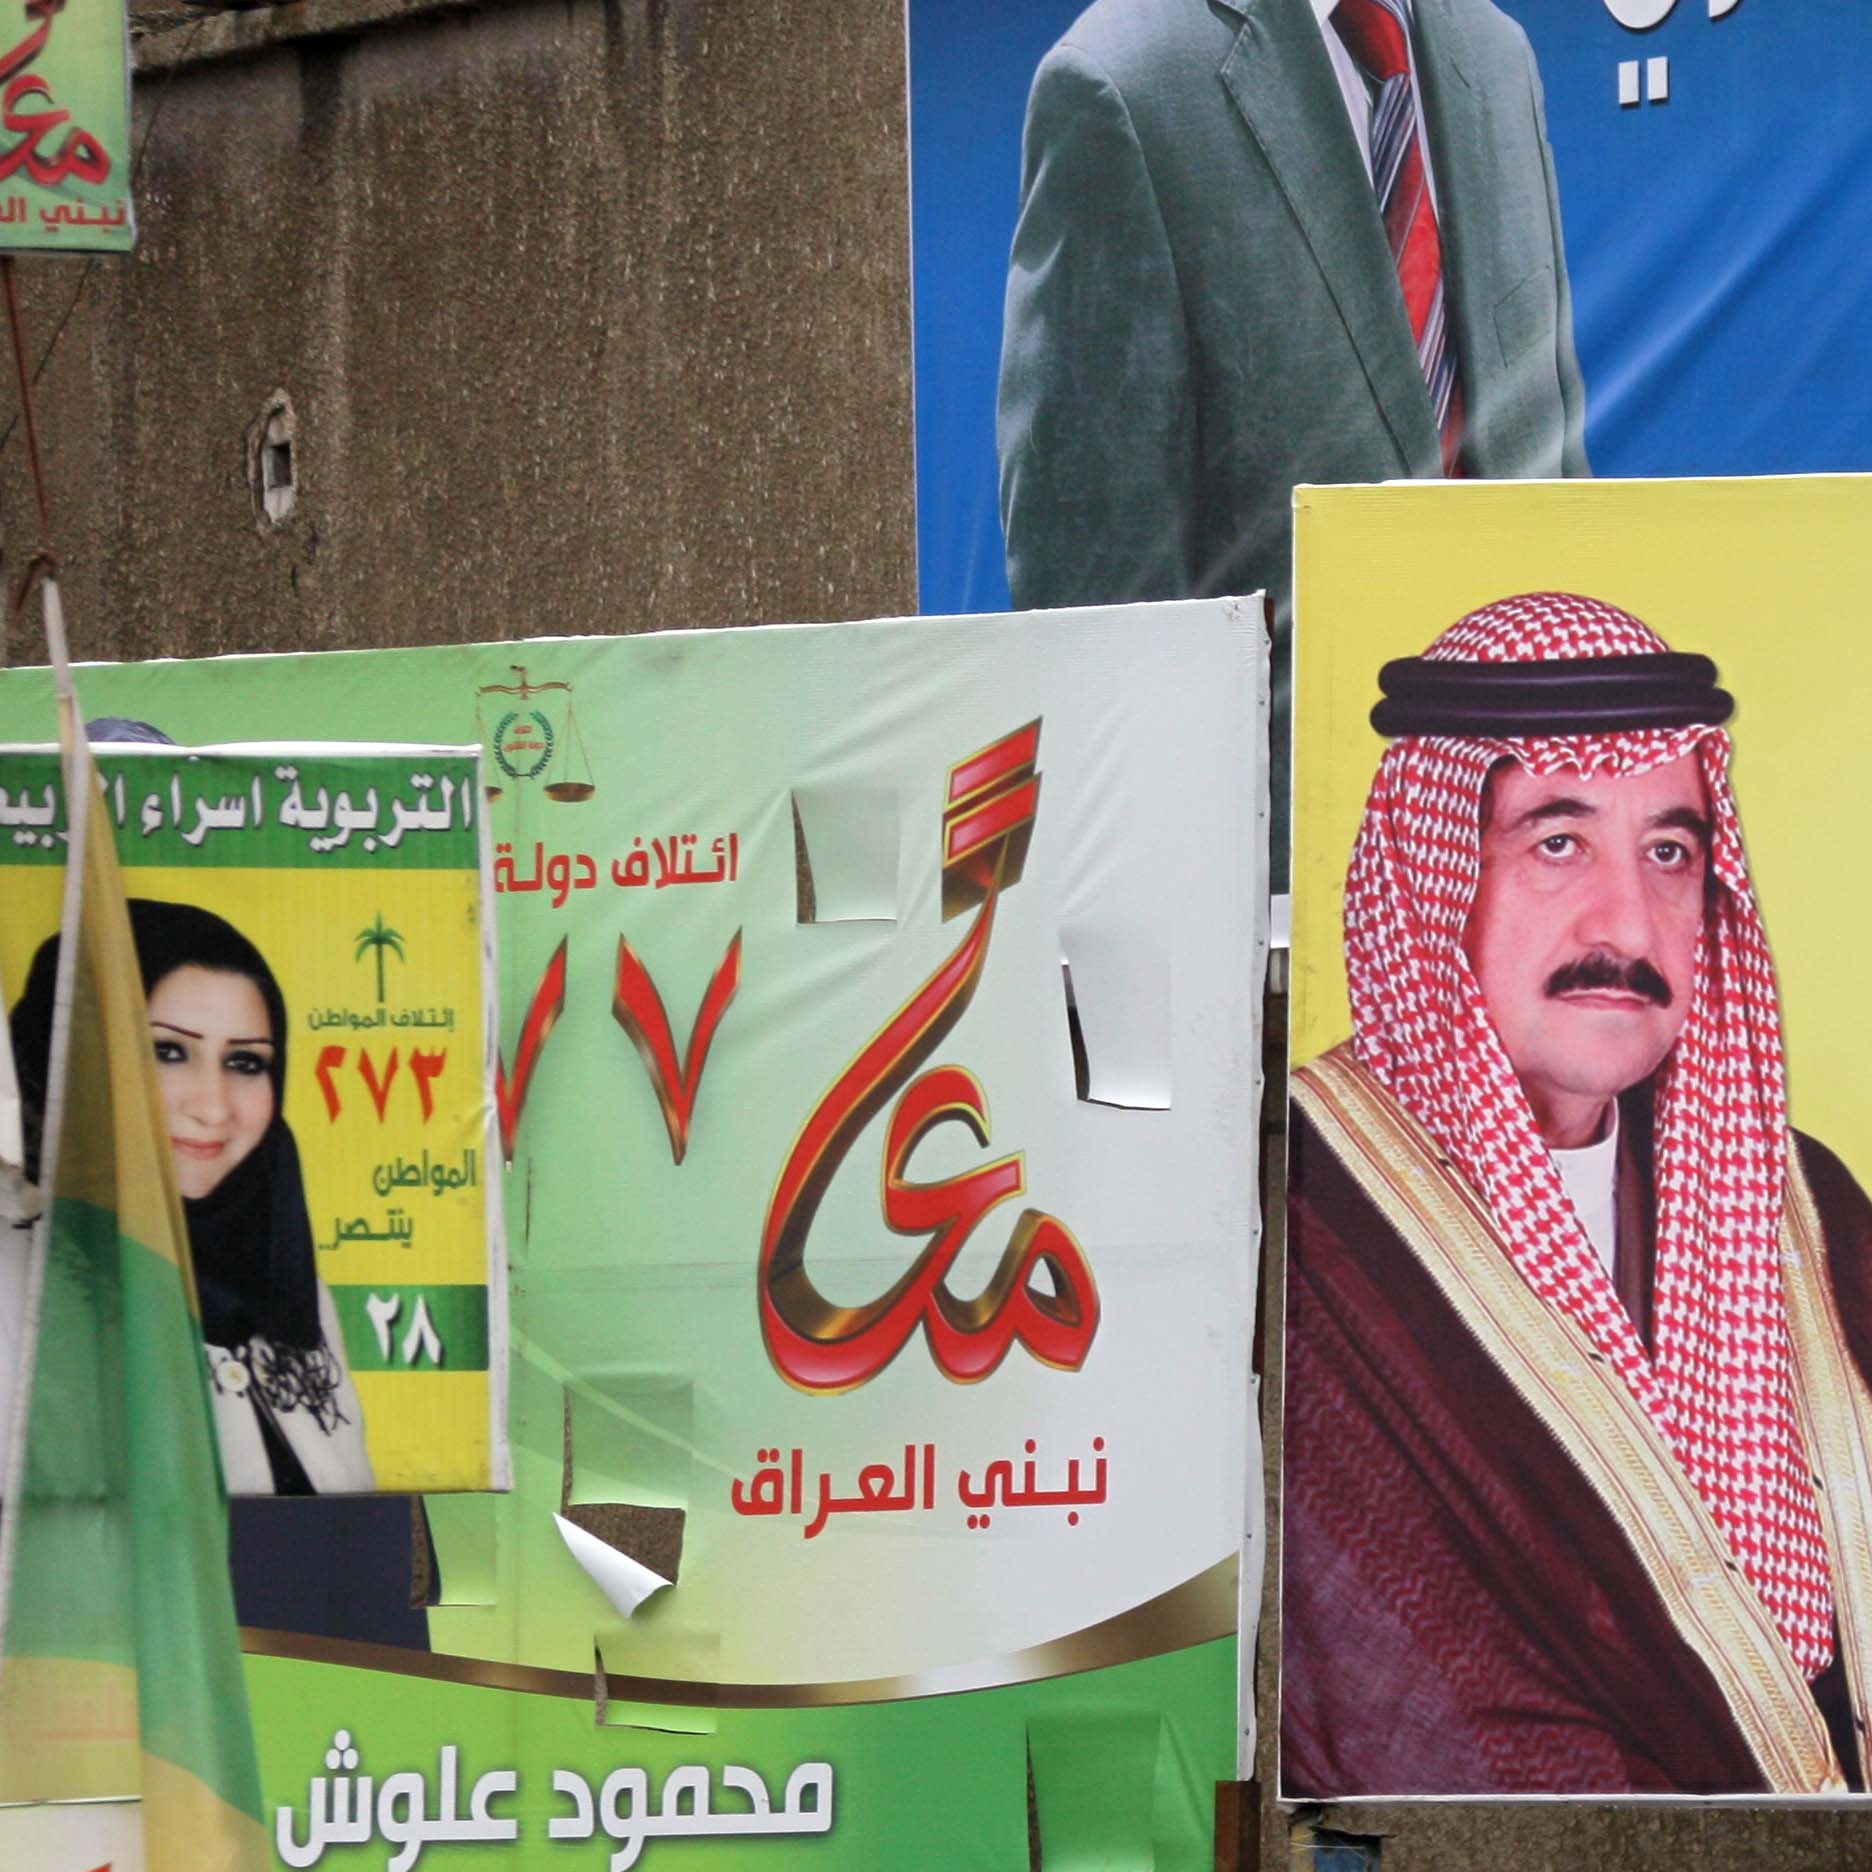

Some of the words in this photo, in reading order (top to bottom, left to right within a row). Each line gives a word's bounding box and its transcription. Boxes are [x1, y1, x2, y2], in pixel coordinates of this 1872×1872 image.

[141, 772, 262, 847] اسراء
[279, 765, 474, 853] التربوية
[494, 841, 598, 909] دولة
[308, 1009, 386, 1032] المواطن
[497, 924, 743, 1168] ٧٧
[314, 1043, 448, 1126] ٢٧٣
[372, 1148, 476, 1197] المواطن
[365, 1291, 444, 1368] ٢٨
[731, 1443, 936, 1540] العراق
[959, 1436, 1108, 1534] نبني
